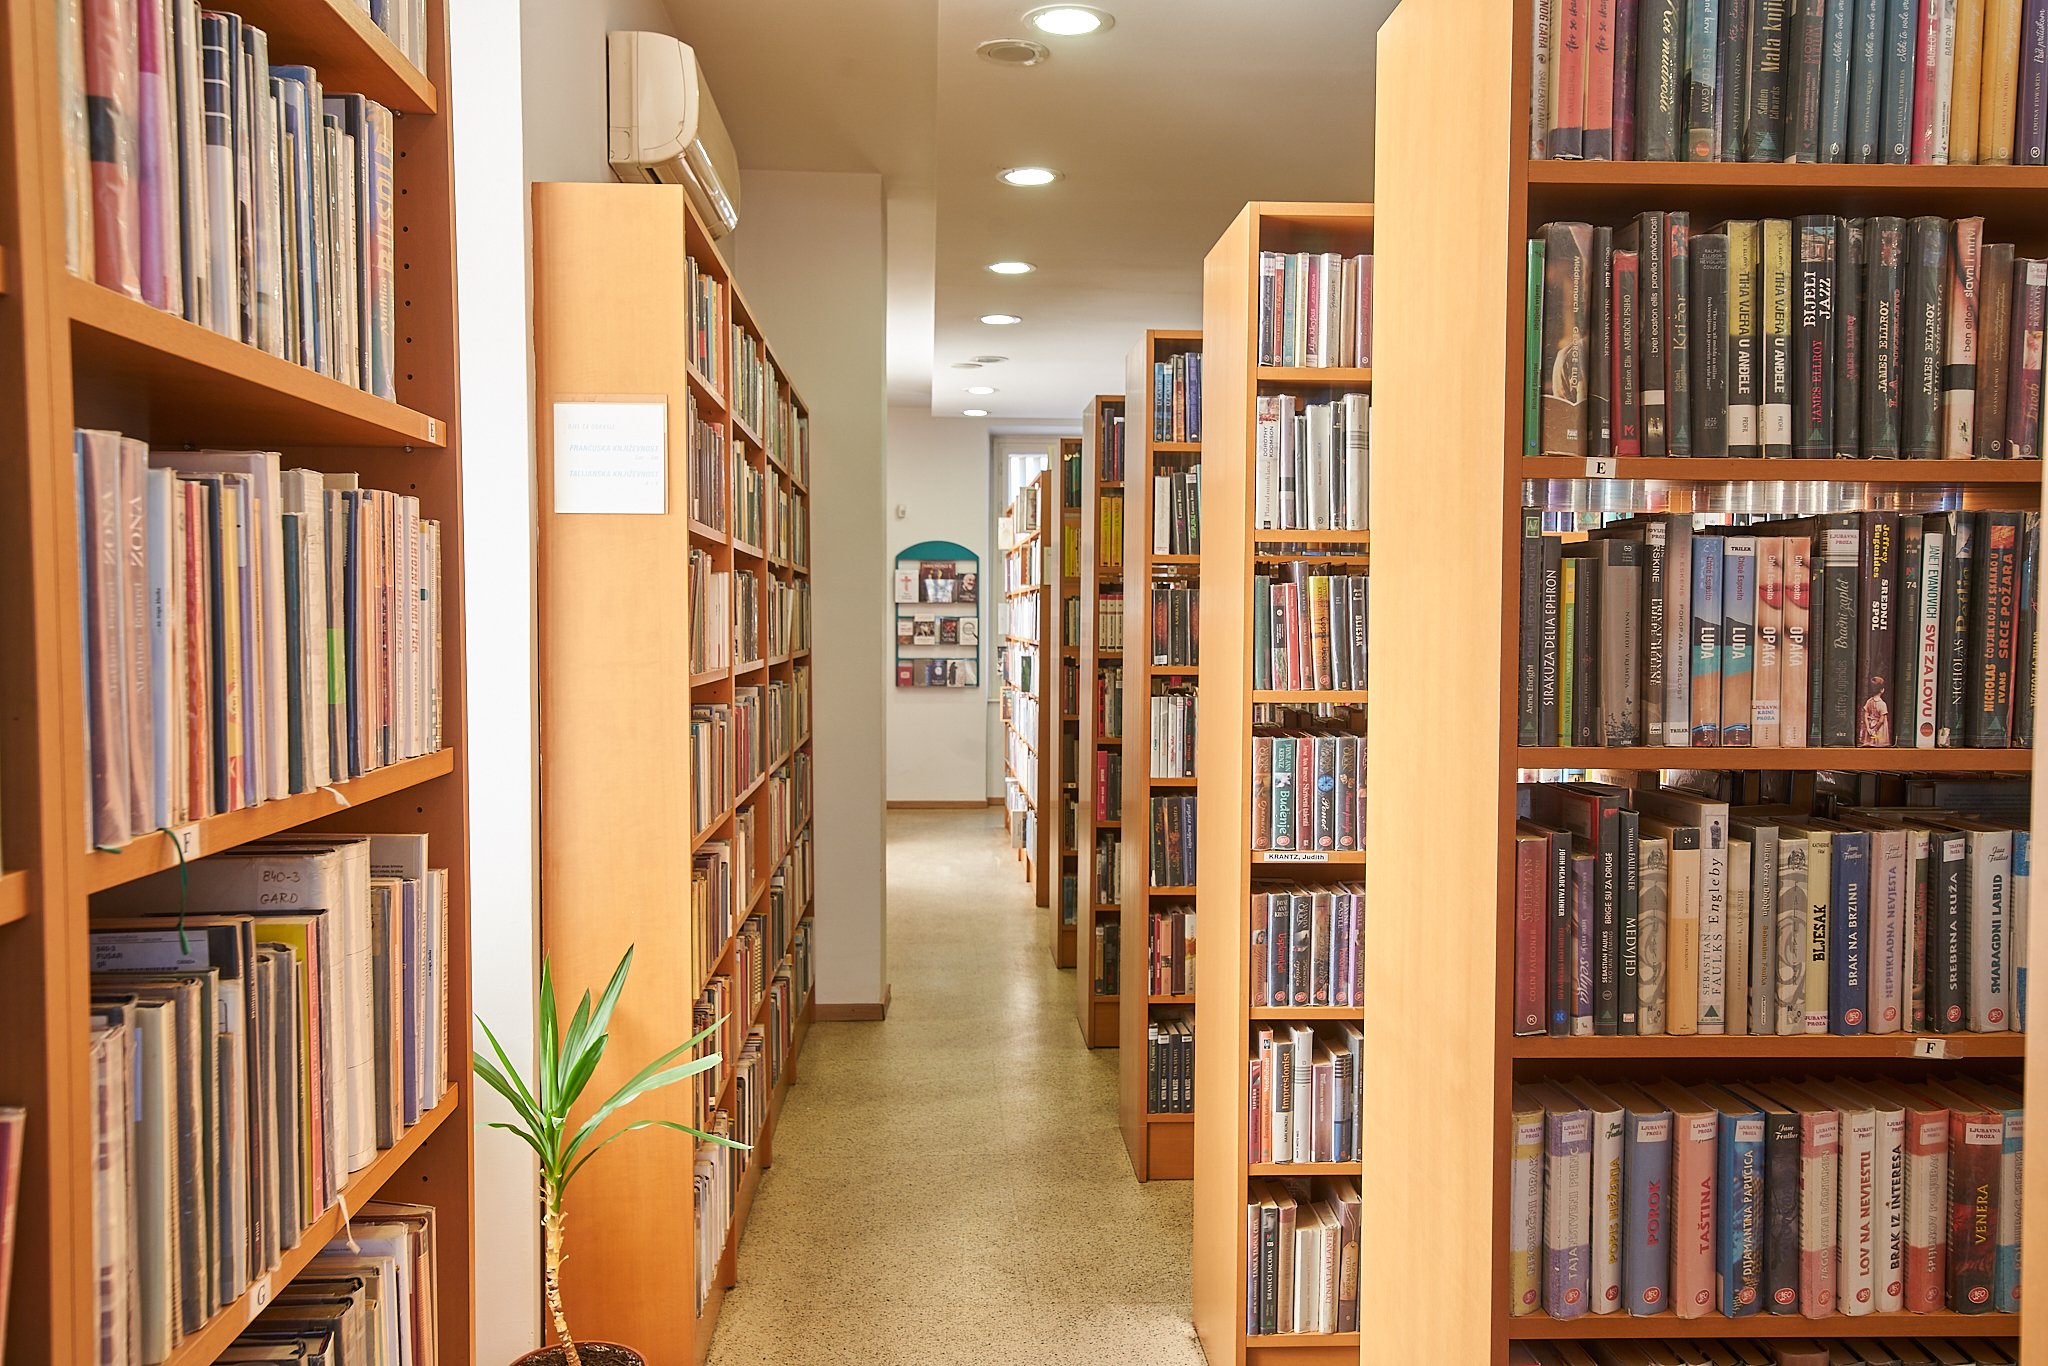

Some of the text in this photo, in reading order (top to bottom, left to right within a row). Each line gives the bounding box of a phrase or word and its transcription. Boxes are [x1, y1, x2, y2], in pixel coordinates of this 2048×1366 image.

[1901, 11, 1909, 28] vole
[1760, 38, 1780, 72] Mala
[1897, 38, 1908, 61] Neki
[1538, 72, 1546, 129] SAM EASTLAND
[1701, 48, 1711, 112] ESI EDUGYAN
[1757, 88, 1768, 114] Selden
[1770, 85, 1780, 119] Edwards
[1650, 216, 1659, 260] privlačnosti
[1651, 262, 1660, 288] pravila
[1803, 271, 1816, 326] BIJELI
[1819, 277, 1831, 319] JAZZ
[1651, 337, 1659, 353] bret
[1673, 293, 1687, 350] Križar
[1774, 271, 1784, 393] TIHA VJERA U ANĐELE
[1878, 300, 1888, 392] JAMES ELLROY
[1923, 303, 1935, 394] JAMES ELLROY
[1622, 294, 1632, 405] Bret Easton Ellis AMERIČKI PSIHO
[1812, 339, 1822, 422] JAMES ELLROY
[1596, 462, 1606, 474] E
[102, 490, 115, 564] ZONA
[1873, 524, 1882, 578] Eugenides
[1880, 524, 1890, 563] Jeffrey
[1880, 579, 1888, 631] SREDNJI
[1986, 563, 1997, 594] SKAKAO
[1986, 596, 1997, 605] JE
[1834, 579, 1854, 649] Bračni zaplet
[1872, 601, 1880, 631] SPOL
[1923, 545, 1940, 717] JANET EVANOVICH SVE ZA LOVU
[1985, 608, 1996, 626] KOJI
[1999, 554, 2013, 659] SRCE POŽARA
[1544, 570, 1556, 706] SIRAKUZA DELIA EPHRON
[1700, 627, 1715, 659] LUDA
[1732, 627, 1746, 659] LUDA
[1762, 627, 1776, 667] OPAKA
[1789, 627, 1803, 667] OPAKA
[1984, 628, 1996, 659] ČOVJEK
[1526, 665, 1535, 714] Anne Enright
[1952, 639, 1964, 705] NICHOLAS
[1984, 664, 1996, 712] NICHOLAS
[1998, 672, 2007, 704] EVANS
[184, 833, 192, 853] F
[260, 891, 298, 904] GARD
[263, 870, 300, 883] 840-3
[1604, 852, 1613, 924] BRIGE SU ZA DRUGE
[1628, 852, 1636, 890] FAULKNER
[1708, 858, 1722, 924] Engleby
[1623, 917, 1637, 976] MEDVJED
[1813, 904, 1826, 961] BLJESAK
[1848, 883, 1858, 986] BRAK NA BRZINU
[1885, 866, 1897, 998] NEPRIKLADNA NEVJESTA
[1948, 872, 1958, 990] SREBRNA RUŽA
[1991, 874, 2002, 994] SMARAGDNI LABUD
[1702, 934, 1710, 996] SEBASTIAN
[1712, 934, 1722, 995] FAULKS
[1926, 1042, 1935, 1054] F
[1281, 1052, 1290, 1109] Impresionist
[1608, 1157, 1620, 1265] POPIS NEŽENJA
[1648, 1180, 1661, 1246] POROK
[1696, 1176, 1711, 1255] TAŠTINA
[1859, 1151, 1872, 1276] LOV NA NEVJESTU
[1890, 1145, 1902, 1270] BRAK IZ INTERESA
[1975, 1184, 1989, 1245] VENERA
[257, 1286, 267, 1304] G
[1325, 1267, 1332, 1276] LA
